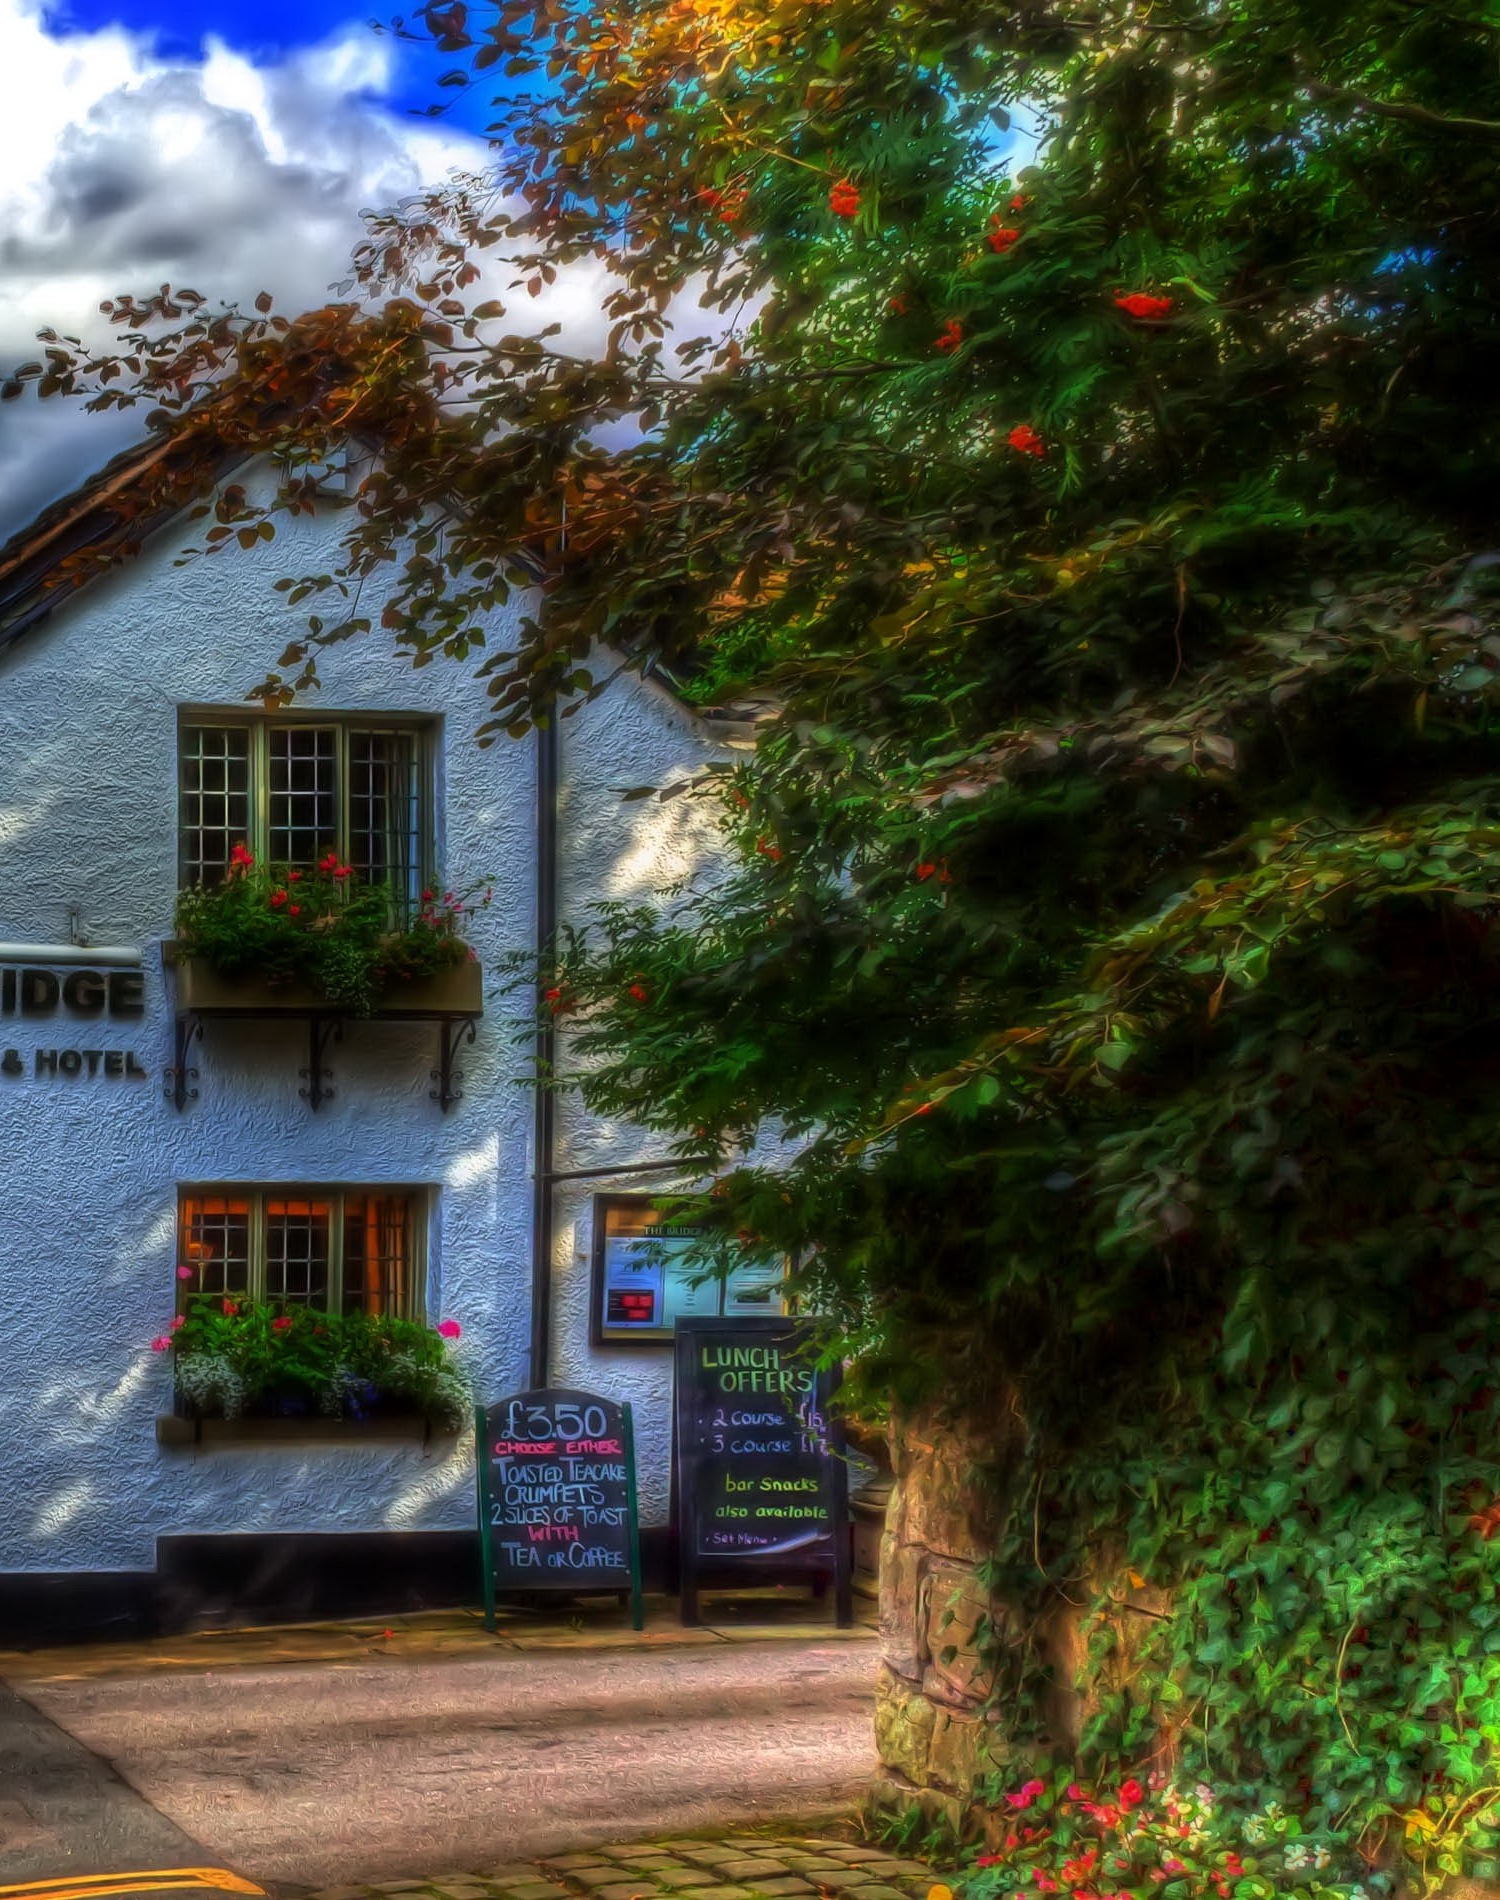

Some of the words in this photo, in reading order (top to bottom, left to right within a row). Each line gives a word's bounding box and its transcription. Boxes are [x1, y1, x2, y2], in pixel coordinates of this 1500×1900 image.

[0, 1049, 23, 1074] &
[35, 1049, 147, 1077] HOTEL
[702, 1347, 779, 1370] LUNCH
[720, 1370, 813, 1393] OFFERS
[501, 1400, 607, 1440] £3.50
[712, 1408, 728, 1427] 2
[495, 1442, 557, 1454] CHOOSE
[566, 1440, 622, 1454] EITHER
[711, 1434, 725, 1453] 3
[492, 1456, 563, 1485] TOASTED
[558, 1456, 628, 1482] TEACAKE
[725, 1473, 754, 1492] bar
[505, 1484, 605, 1505] CRUMPETS
[491, 1503, 504, 1525] 2
[553, 1506, 574, 1524] OF
[577, 1506, 629, 1528] TOAST
[715, 1505, 748, 1518] also
[756, 1506, 828, 1520] available
[527, 1525, 579, 1541] WITH
[713, 1532, 734, 1544] Set
[501, 1542, 541, 1567] TEA
[568, 1542, 628, 1568] COFFEE
